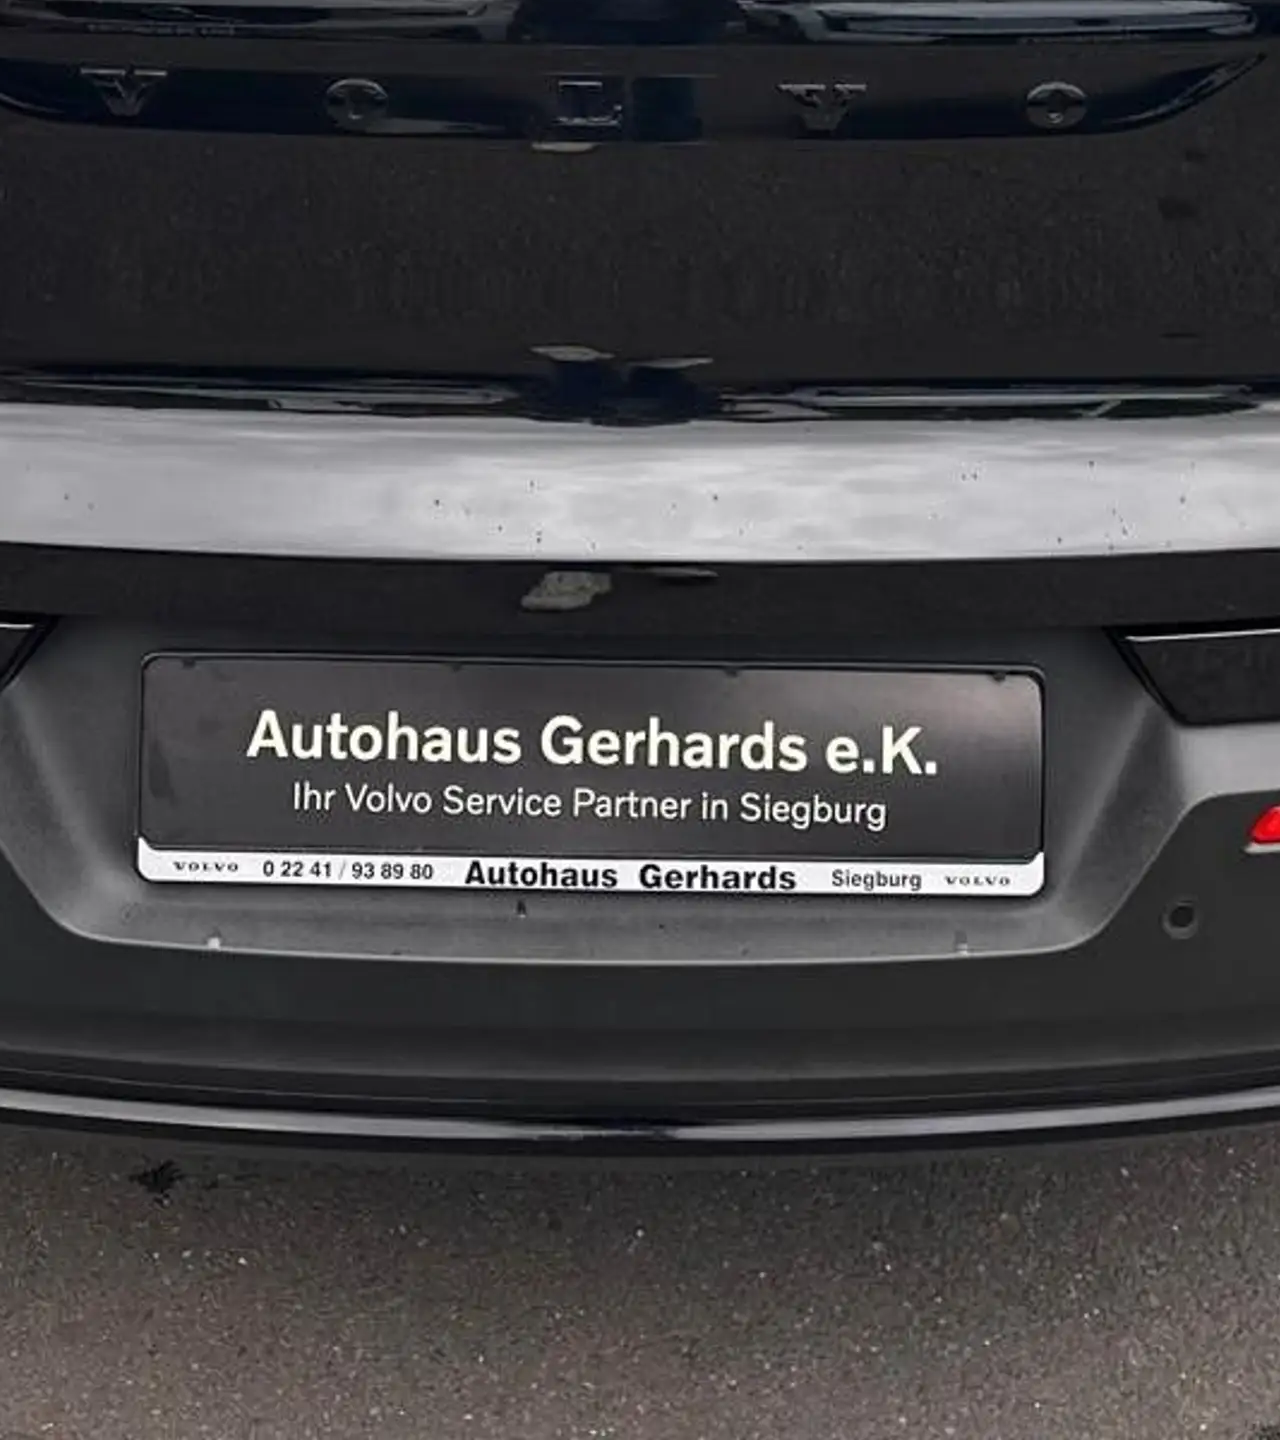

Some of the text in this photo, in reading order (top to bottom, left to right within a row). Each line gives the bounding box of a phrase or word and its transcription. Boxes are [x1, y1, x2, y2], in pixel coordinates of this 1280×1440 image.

[78, 67, 1089, 133] VOLVO
[245, 708, 938, 776] Autohaus Gerhards e.K.
[293, 780, 887, 833] Ihr Volvo Service Partner in Siegburg
[172, 861, 239, 873] VOLVO
[262, 861, 274, 878] 0
[280, 861, 303, 878] 22
[310, 862, 332, 878] 41
[352, 862, 375, 879] 93
[381, 863, 404, 880] 89
[410, 863, 434, 880] 80
[465, 859, 619, 888] Autohaus
[639, 863, 797, 890] Gerhards
[831, 868, 922, 891] Siegburg
[945, 875, 1012, 886] VOLVO
